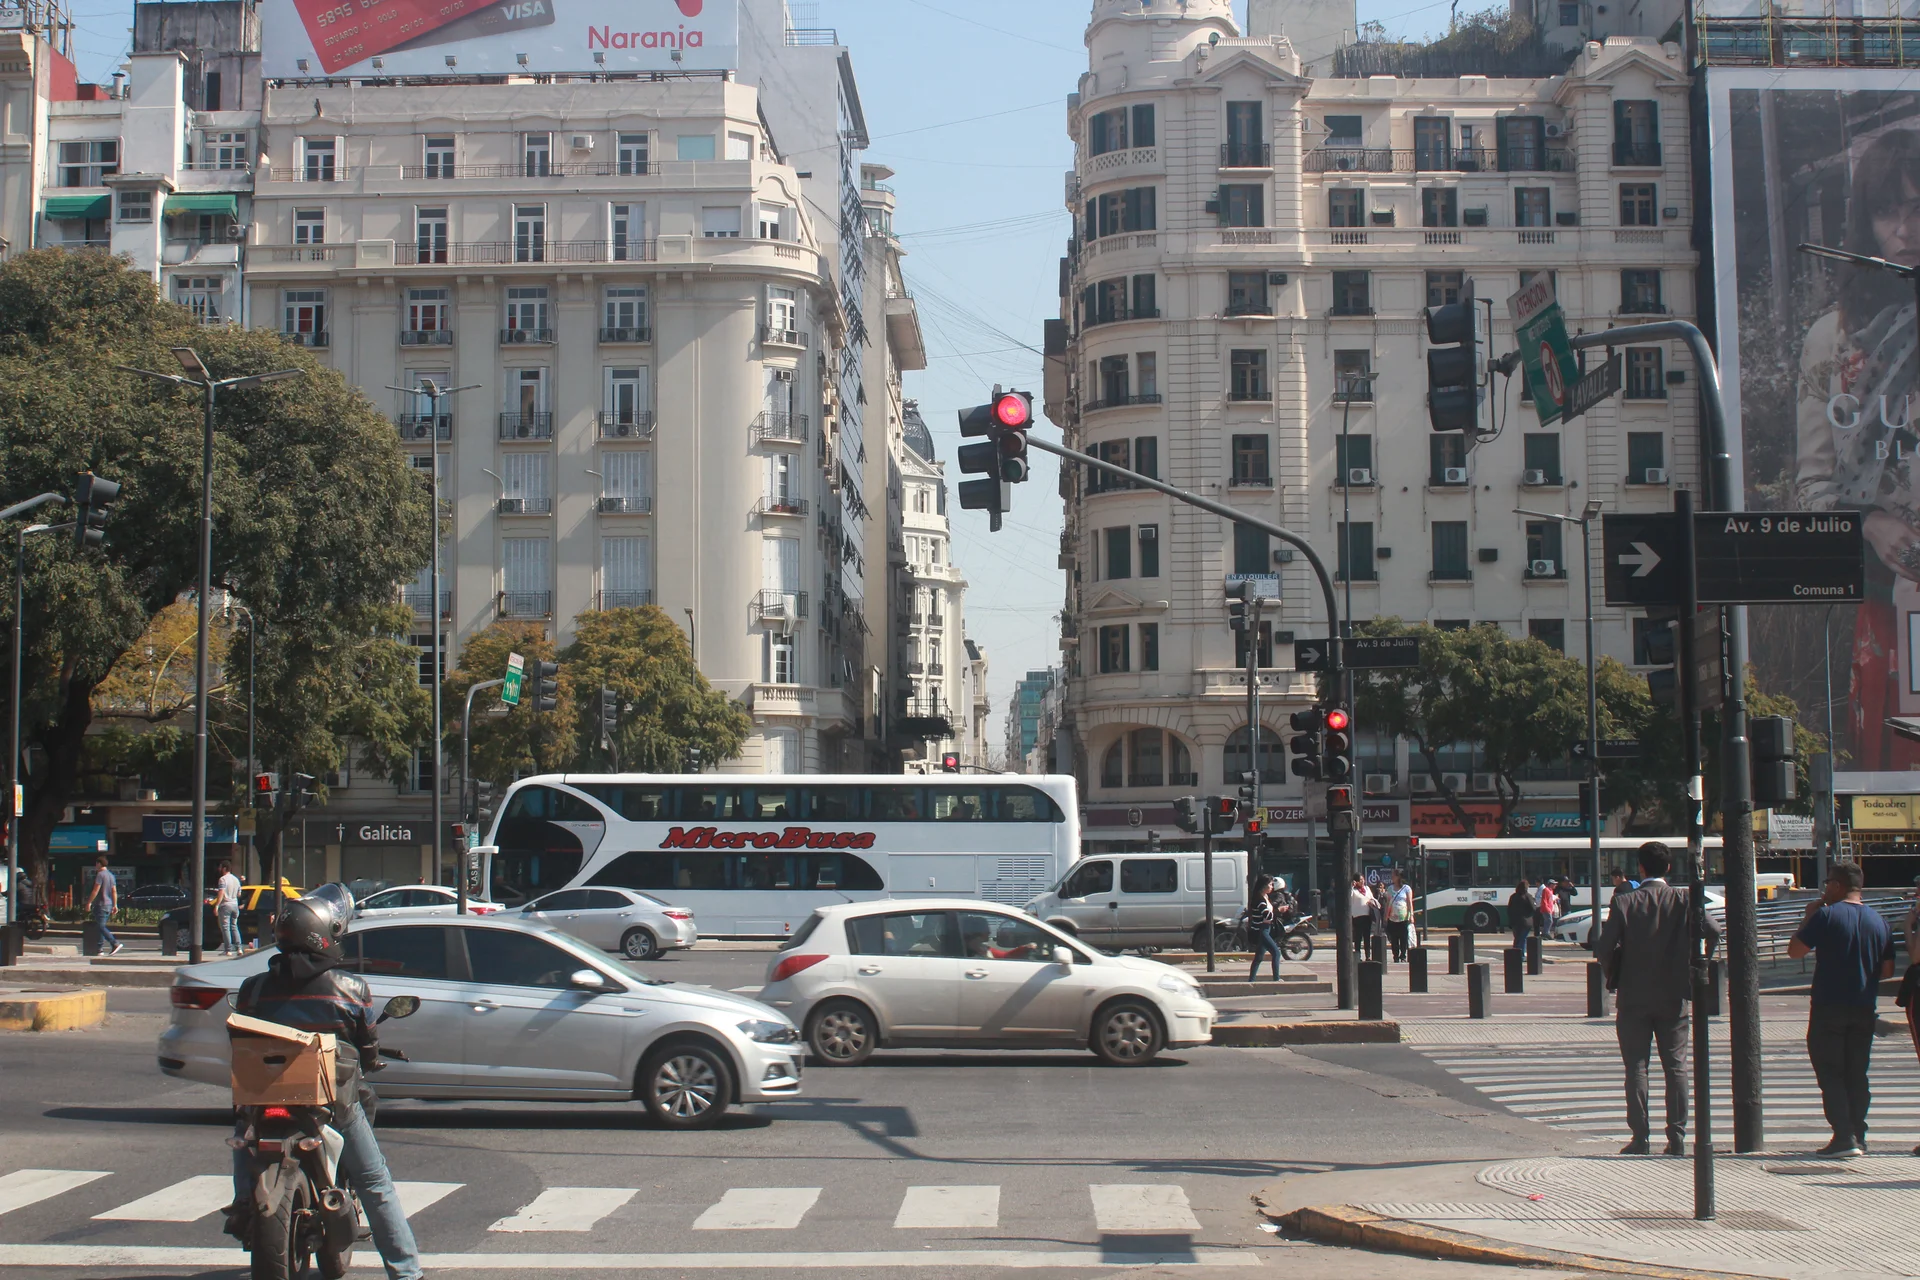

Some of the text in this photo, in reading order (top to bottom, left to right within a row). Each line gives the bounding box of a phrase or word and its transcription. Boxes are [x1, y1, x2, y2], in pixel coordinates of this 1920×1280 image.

[316, 3, 353, 28] 5895
[501, 1, 546, 21] VISA
[323, 26, 360, 47] EDUARDO
[587, 24, 703, 51] Naranja
[1515, 281, 1548, 321] ATENCION
[1571, 365, 1609, 413] LAVALLE
[1875, 440, 1920, 460] BL
[1724, 516, 1852, 533] Av. 9 de Julio
[1793, 584, 1855, 596] Comuna 1
[1356, 638, 1414, 648] Av. 9 de Julio
[1862, 799, 1884, 808] Todo
[1286, 809, 1304, 819] ZER
[1362, 809, 1390, 818] PLAN
[1514, 815, 1537, 828] 365
[179, 821, 213, 829] RUY
[1541, 817, 1581, 829] HALLS
[179, 829, 213, 837] STE
[359, 824, 412, 841] Galicia
[659, 826, 876, 849] MicroBusa
